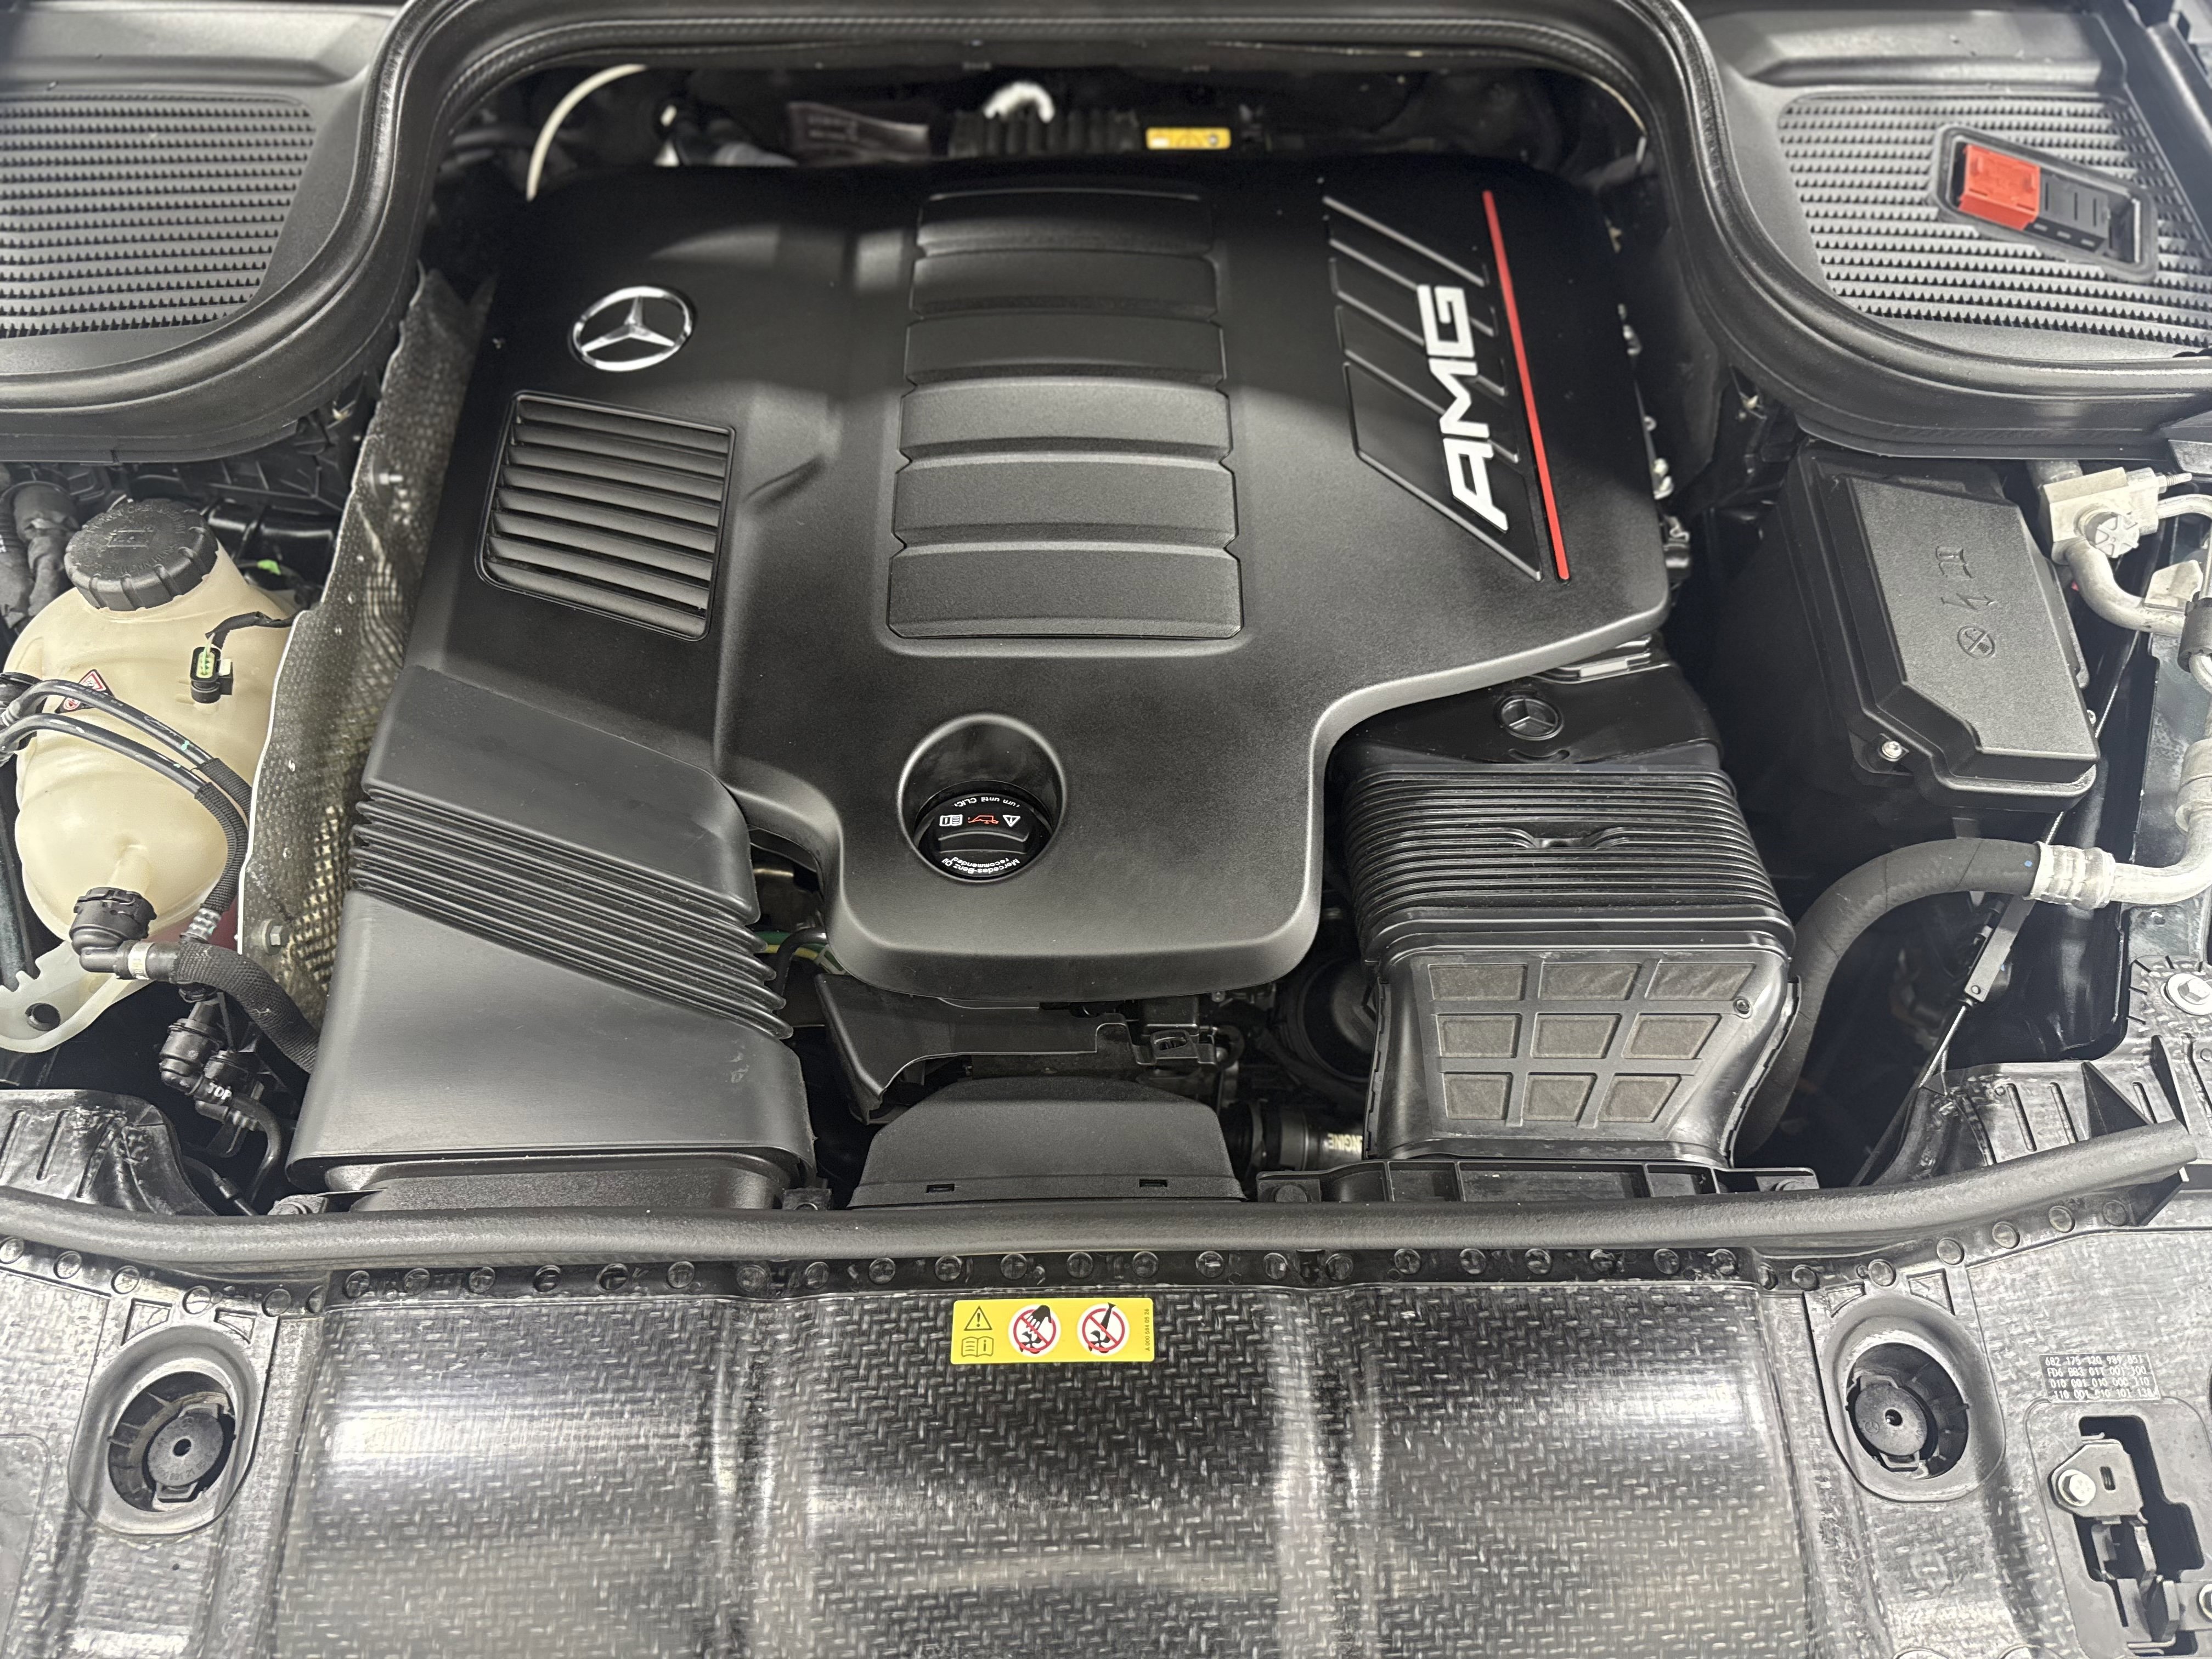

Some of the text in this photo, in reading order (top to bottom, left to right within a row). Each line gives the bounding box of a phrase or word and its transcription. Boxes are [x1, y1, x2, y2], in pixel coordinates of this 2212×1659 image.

[1417, 284, 1509, 532] AMG
[941, 857, 1020, 874] Mercedes-Benz Oil
[951, 856, 1009, 868] recommended
[206, 1082, 232, 1100] TOP
[2066, 1357, 2082, 1365] 175
